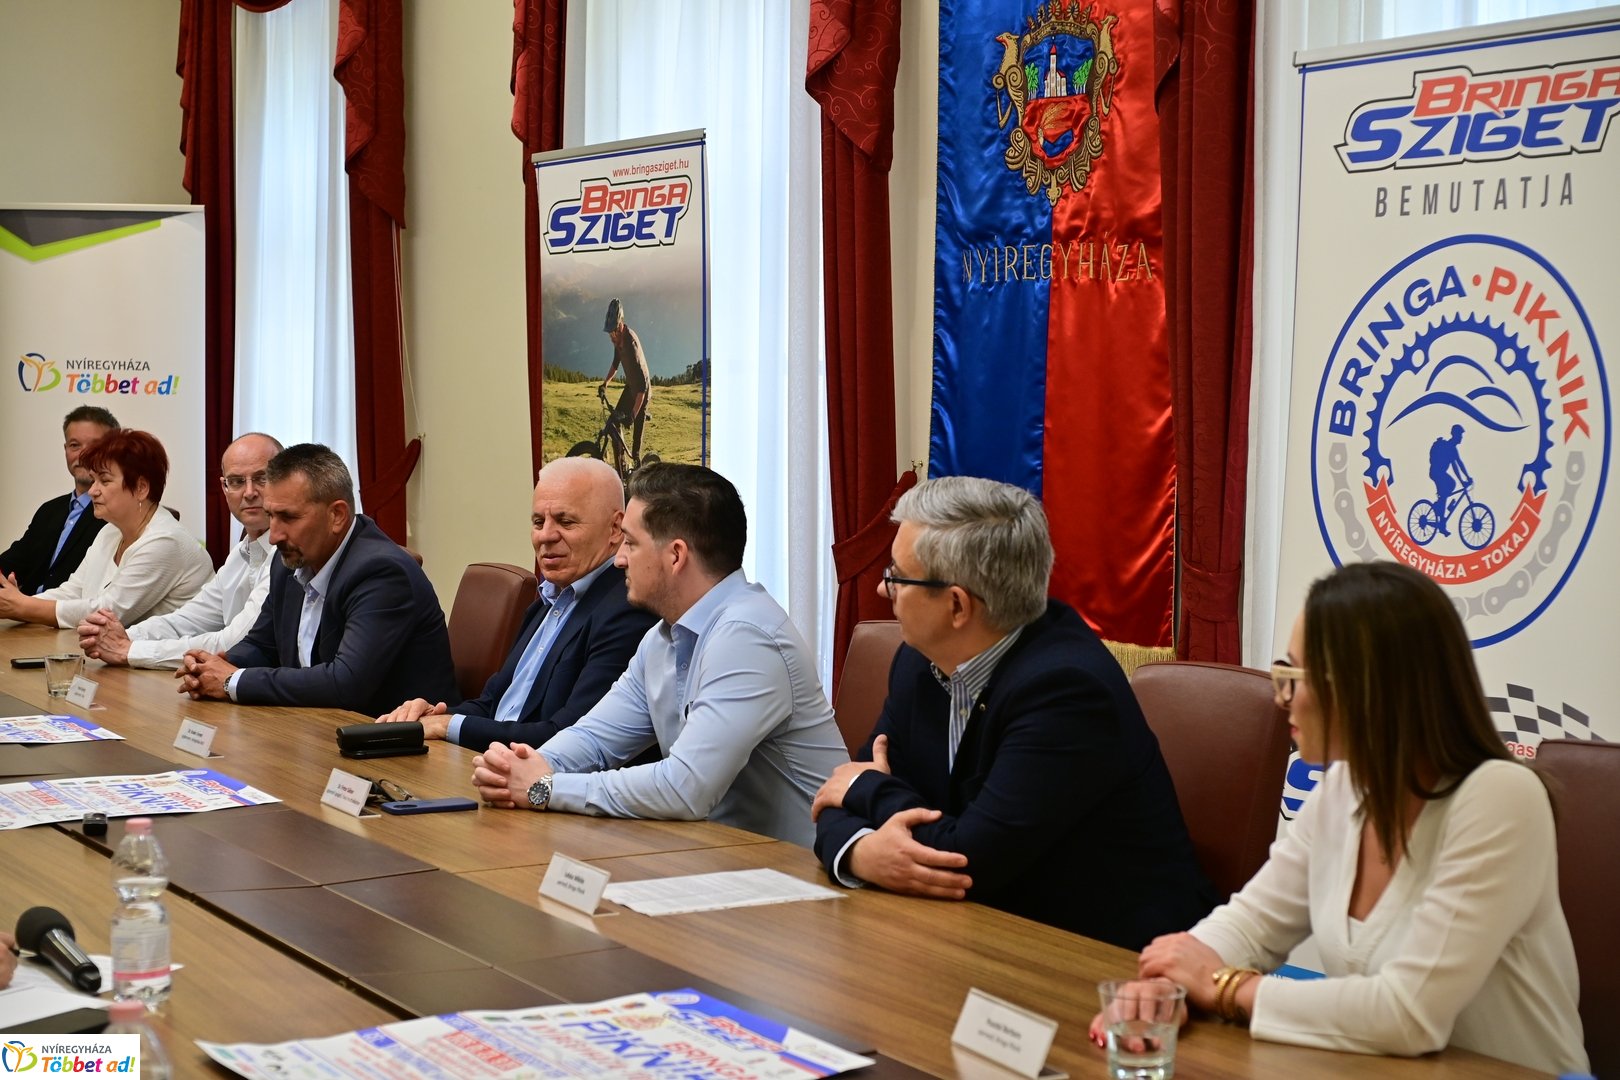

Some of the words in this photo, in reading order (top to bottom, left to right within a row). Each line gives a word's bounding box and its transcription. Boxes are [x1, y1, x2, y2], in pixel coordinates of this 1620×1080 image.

[1413, 66, 1620, 117] BRINGA
[1346, 98, 1620, 164] SZIGET
[612, 158, 690, 178] www.bringasziget.hu
[581, 182, 688, 217] BRINGA
[1375, 172, 1573, 218] BEMUTATJA
[548, 206, 684, 248] SZIGET
[66, 358, 150, 371] NYÍREGYHÁZA
[1328, 265, 1467, 437] BRINGA
[1485, 266, 1591, 445] PIKNIK
[66, 373, 140, 395] Többet
[144, 374, 180, 395] ad!
[1375, 510, 1467, 579] NYÍREGYHÁZA
[1482, 520, 1531, 570] TOKAJ
[663, 1041, 758, 1080] BRING
